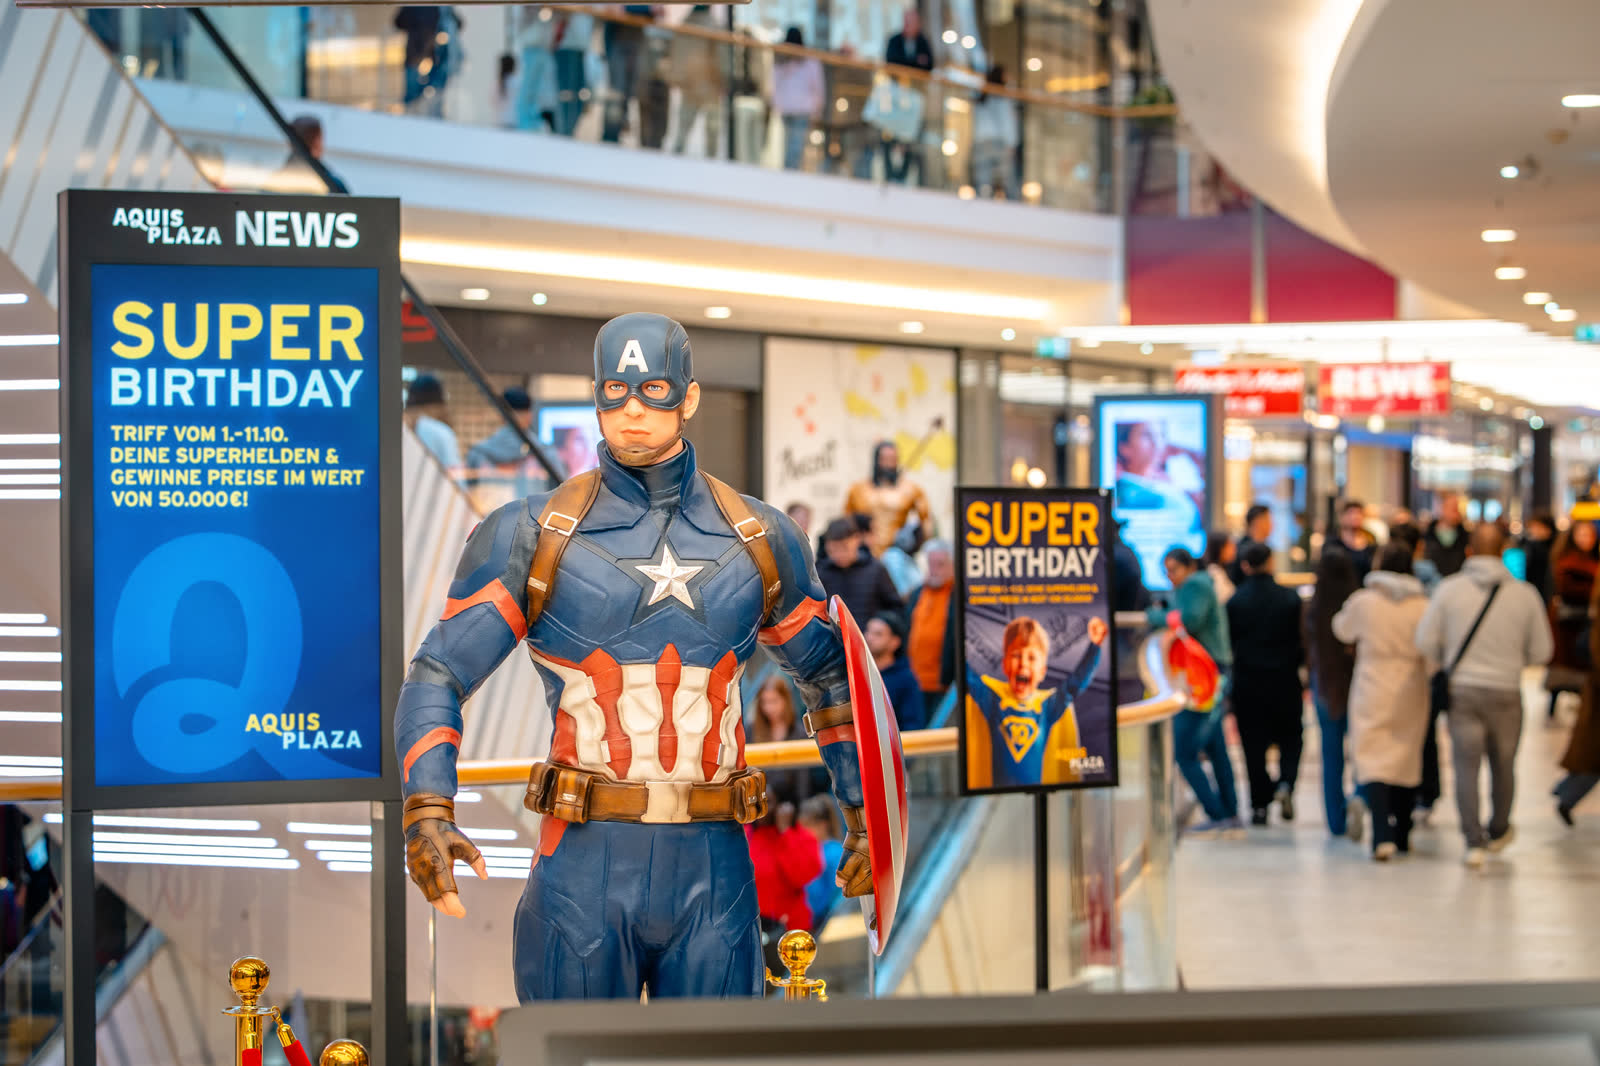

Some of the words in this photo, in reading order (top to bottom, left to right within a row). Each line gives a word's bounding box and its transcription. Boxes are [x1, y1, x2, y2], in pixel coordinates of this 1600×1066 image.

[112, 207, 184, 231] AQUIS
[235, 210, 360, 248] NEWS
[147, 226, 222, 245] PLAZA
[111, 300, 364, 360] SUPER
[616, 339, 649, 373] A
[111, 367, 364, 407] BIRTHDAY
[110, 425, 168, 442] TRIFF
[174, 426, 216, 442] VOM
[110, 447, 170, 464] DEINE
[176, 447, 320, 464] SUPERHELDEN
[325, 448, 339, 464] &
[110, 469, 201, 486] GEWINNE
[207, 469, 278, 486] PREISE
[284, 469, 305, 486] IM
[311, 469, 364, 486] WERT
[111, 490, 152, 507] VON
[158, 490, 249, 508] 50.000€!
[966, 501, 1099, 546] SUPER
[966, 547, 1099, 578] BIRTHDAY
[245, 712, 320, 736] AQUIS
[282, 730, 362, 749] PLAZA
